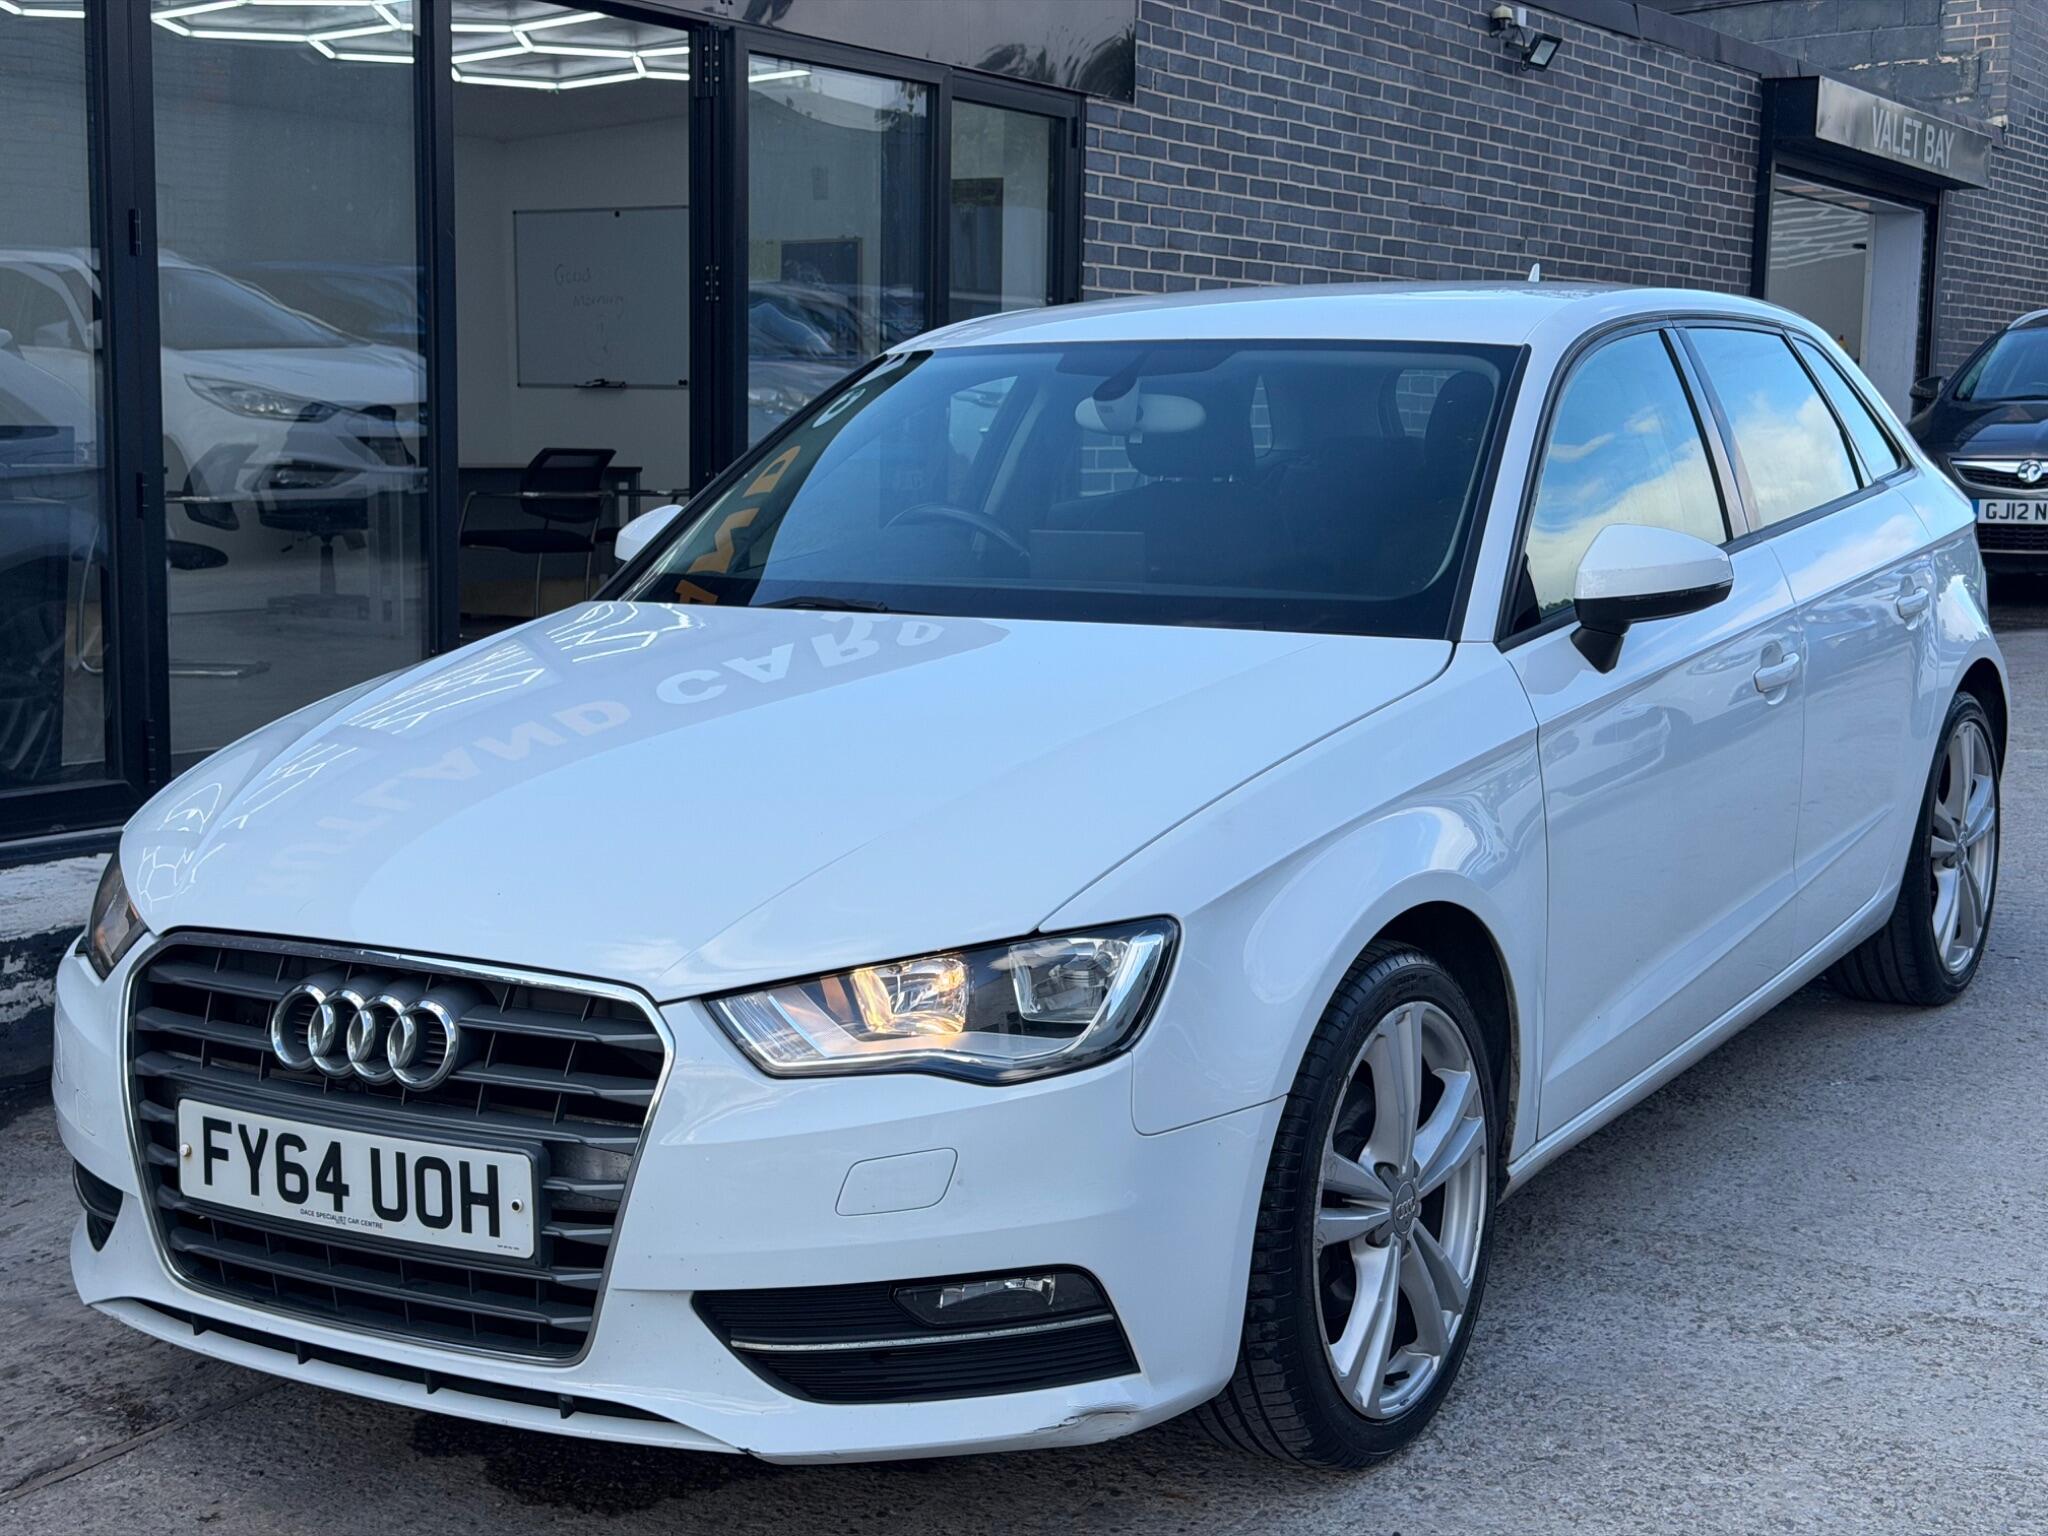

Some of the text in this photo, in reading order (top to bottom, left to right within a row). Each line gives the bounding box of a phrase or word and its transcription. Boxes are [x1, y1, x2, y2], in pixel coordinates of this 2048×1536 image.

[1872, 106, 1955, 169] VALET BAY
[1985, 502, 2029, 521] GJ12
[202, 1116, 501, 1238] FY64 UOH
[316, 1212, 347, 1222] SPECIALIST
[348, 1217, 360, 1225] CAR
[361, 1219, 384, 1229] CENTRE
